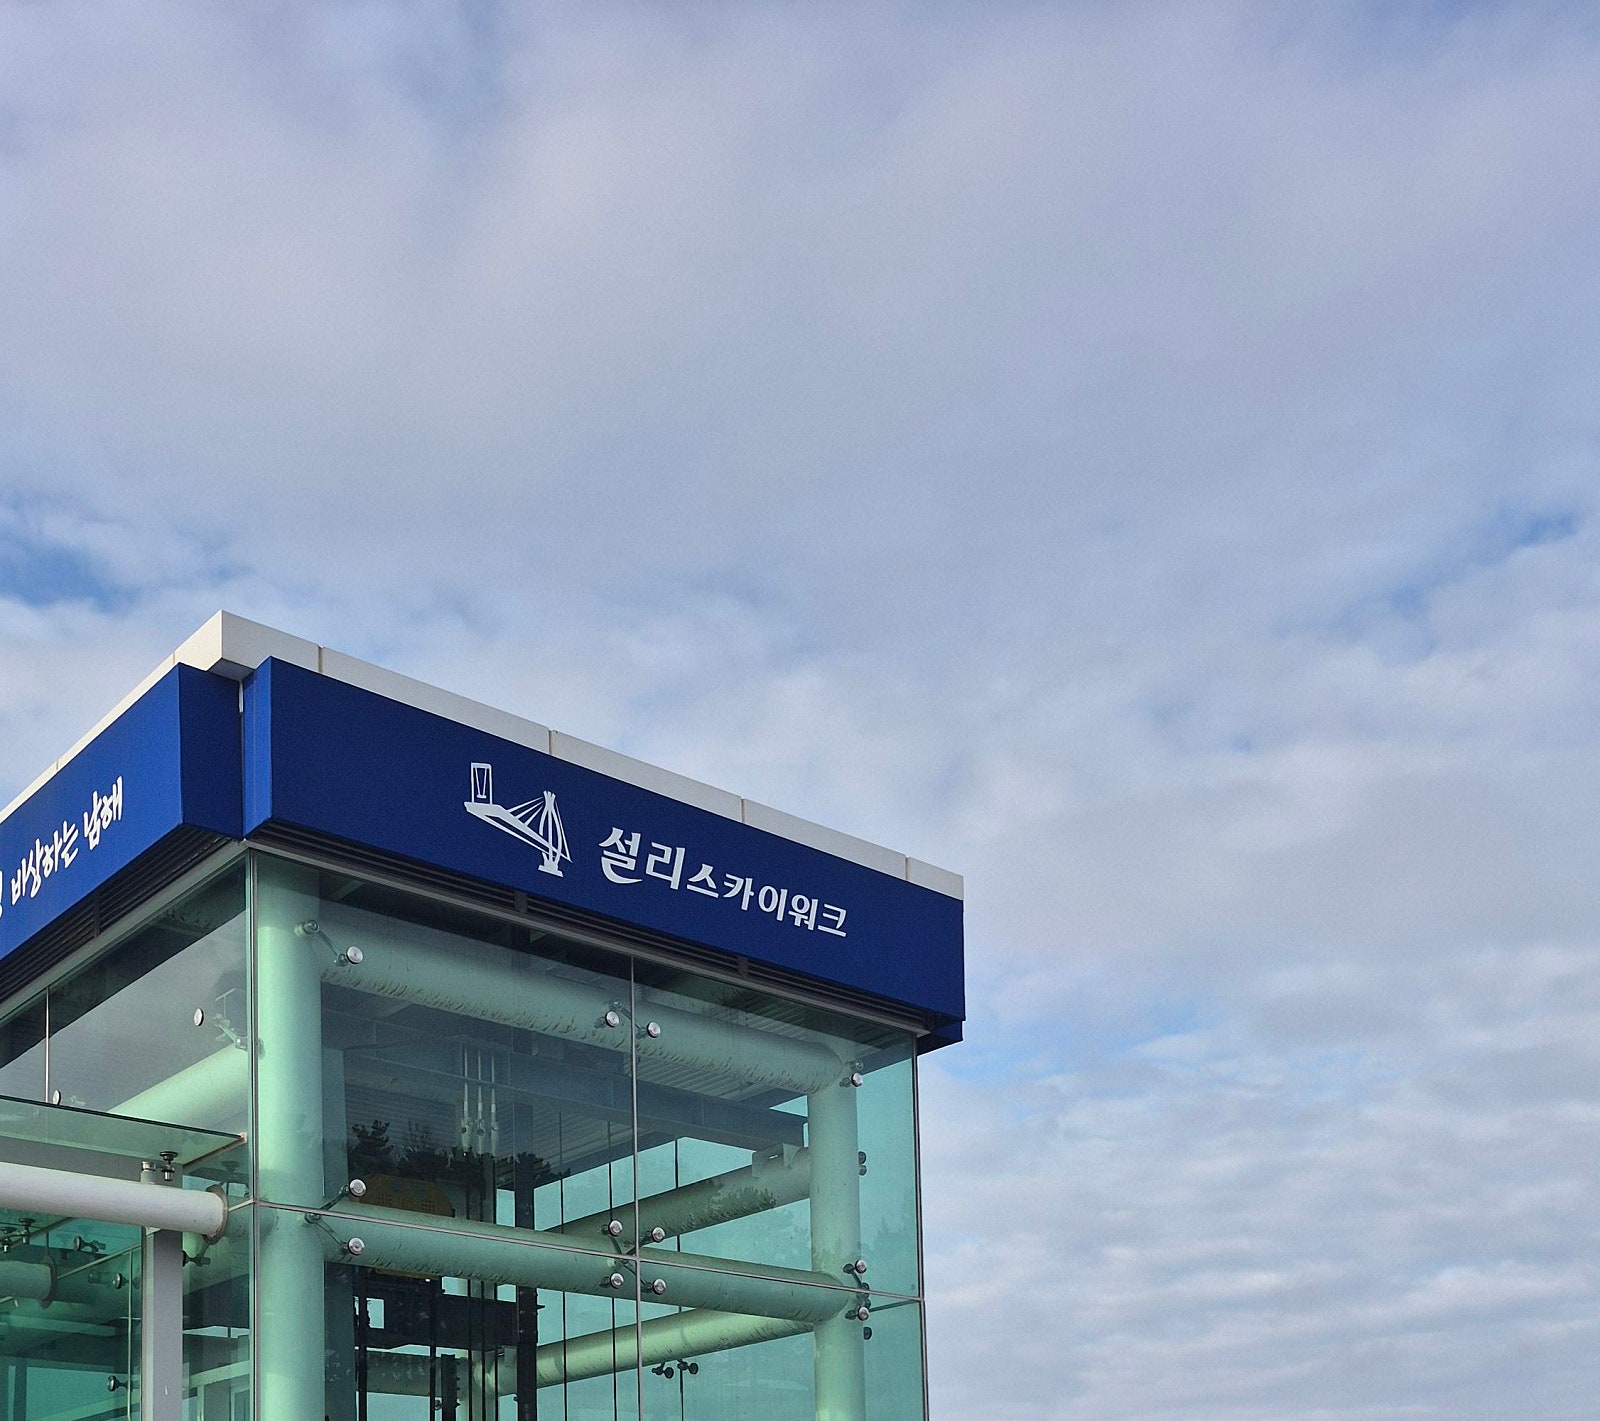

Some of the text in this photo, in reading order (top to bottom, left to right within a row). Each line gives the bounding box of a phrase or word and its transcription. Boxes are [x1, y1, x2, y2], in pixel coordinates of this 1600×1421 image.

[11, 821, 79, 906] 비상하는
[83, 775, 123, 850] 남해
[598, 827, 848, 938] 설리스카이워크
